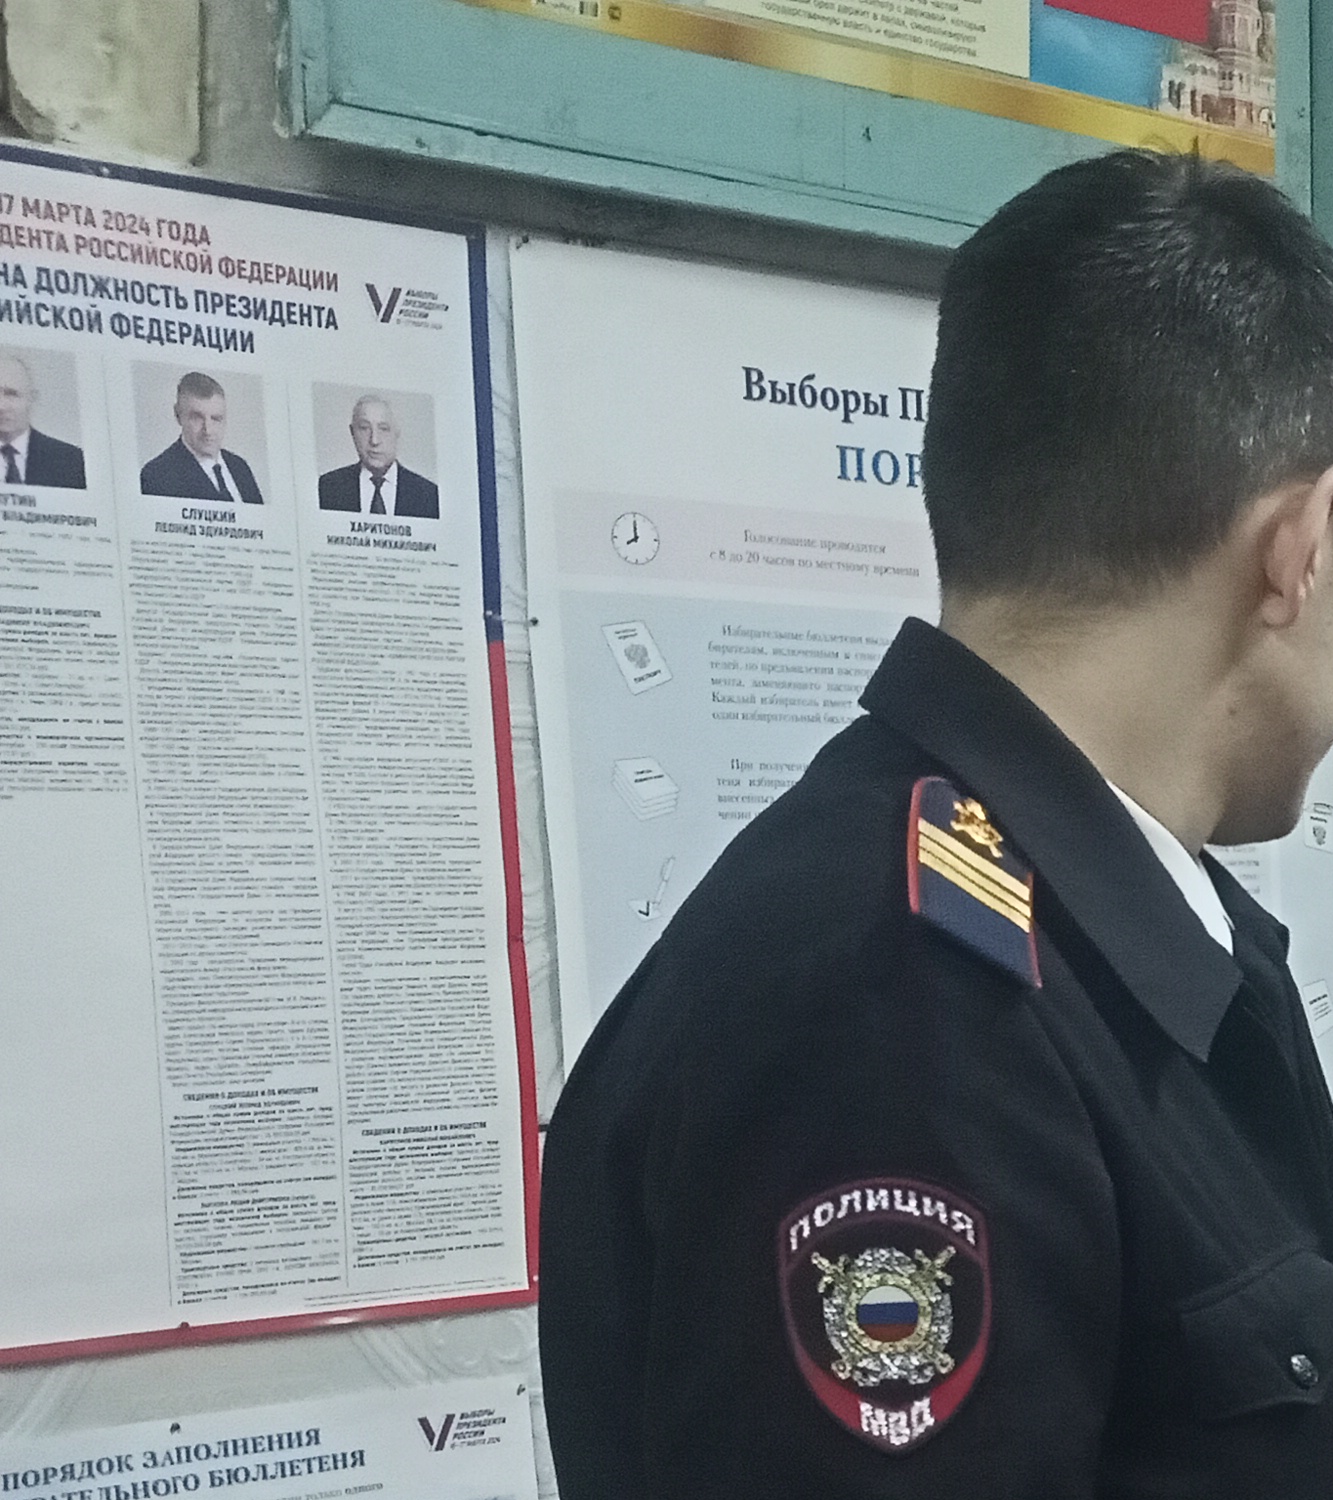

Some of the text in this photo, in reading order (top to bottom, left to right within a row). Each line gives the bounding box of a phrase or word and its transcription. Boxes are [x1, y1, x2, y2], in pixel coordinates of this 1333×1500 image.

[22, 196, 97, 229] МАРТА
[102, 209, 150, 237] 2024
[156, 217, 211, 247] ГОДА
[75, 234, 213, 275] РОССИЙСКОЙ
[218, 255, 339, 293] ФЕДЕРАЦИИ
[34, 266, 188, 311] ДОЛЖНОСТЬ
[194, 289, 339, 331] ПРЕЗИДЕНТА
[110, 312, 256, 354] ФЕДЕРАЦИИ
[741, 365, 926, 425] Выборы П
[836, 444, 923, 489] ПОР
[2, 510, 98, 528] ВЛАДИМИРОВИЧ
[155, 521, 264, 541] ЛЕОНИД ЭДУАРДОВИЧ
[181, 507, 237, 525] СЛУЦКИЙ
[349, 520, 412, 537] ХАРИТОНОВ
[326, 533, 437, 553] НИКОЛАЙ МИХАЙЛОВИЧ
[718, 550, 727, 562] 8
[729, 552, 744, 565] до
[745, 551, 760, 565] 20
[762, 555, 796, 568] часов
[815, 559, 871, 577] местному
[873, 563, 921, 578] времени
[789, 1187, 977, 1251] ПОЛИЦИЯ
[858, 1396, 936, 1447] МВД
[1, 1427, 322, 1493] ПОРЯДОК ЗАПОЛНЕНИЯ
[207, 1448, 367, 1490] БЮЛЛЕТЕНЯ
